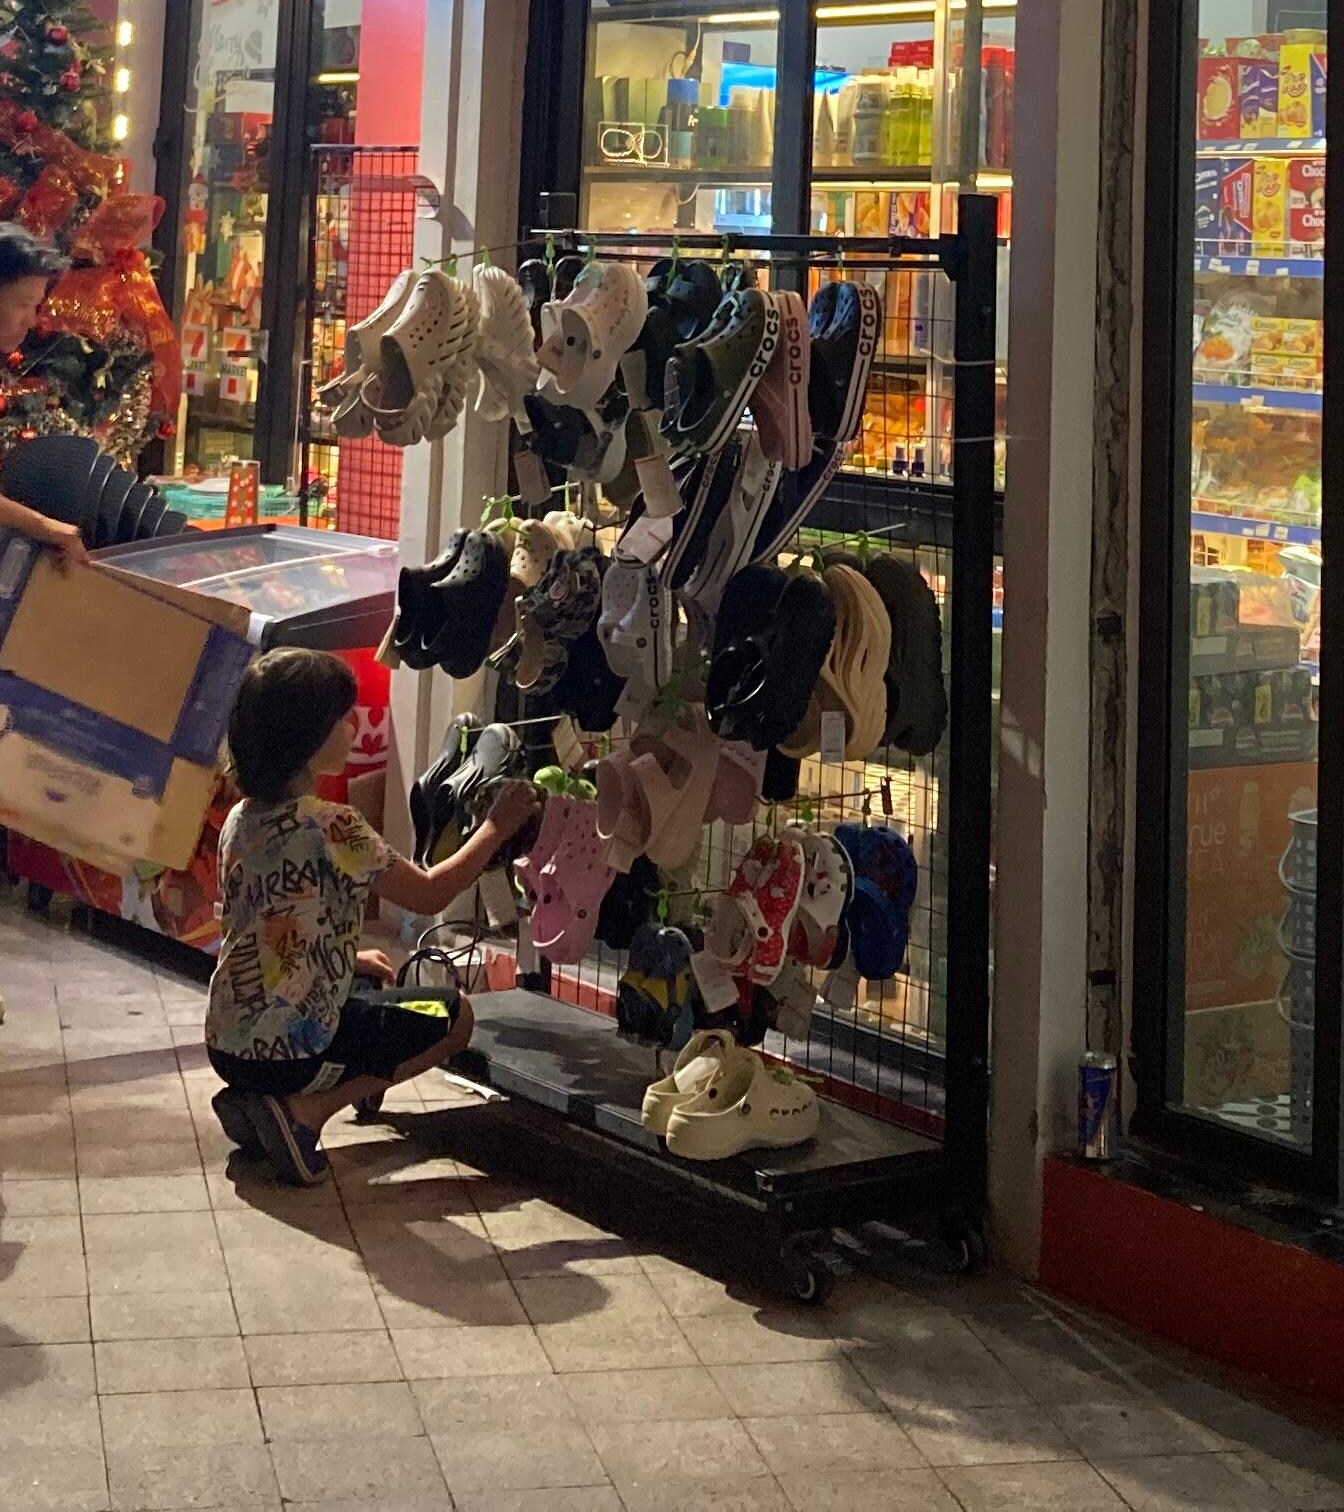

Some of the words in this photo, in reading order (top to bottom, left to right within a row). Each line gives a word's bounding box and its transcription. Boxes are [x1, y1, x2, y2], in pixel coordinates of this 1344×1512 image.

[750, 308, 779, 379] crocs
[786, 317, 802, 385] crocs
[859, 289, 875, 356] crocs
[646, 575, 660, 629] crocs
